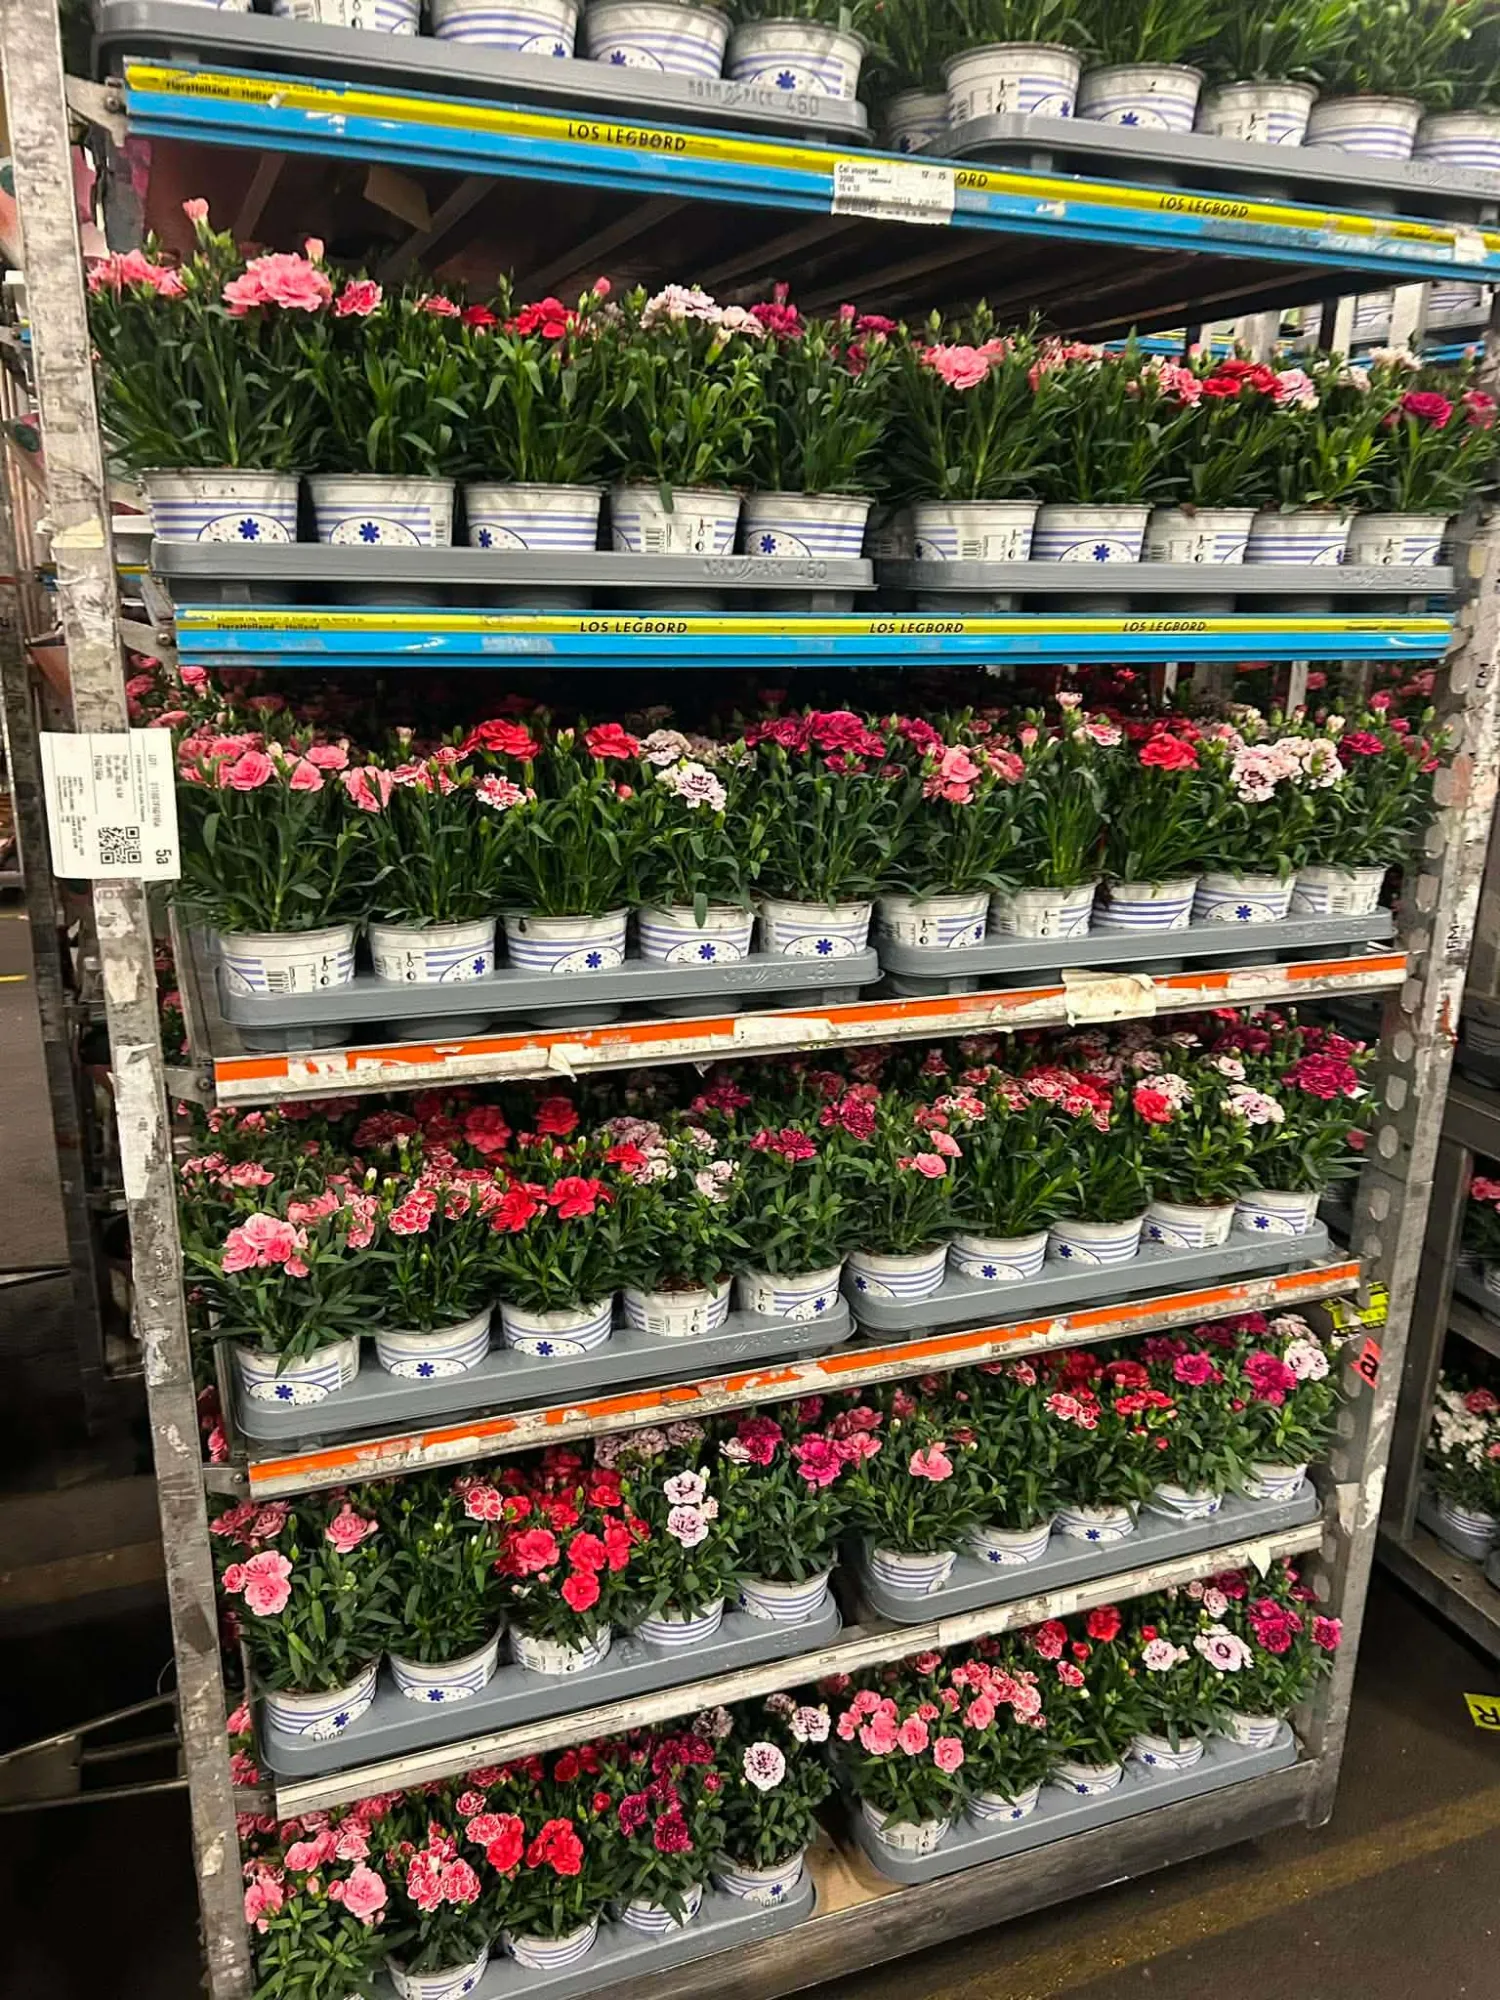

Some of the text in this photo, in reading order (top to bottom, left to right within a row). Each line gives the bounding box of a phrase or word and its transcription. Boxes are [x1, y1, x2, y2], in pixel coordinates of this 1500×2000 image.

[568, 123, 687, 152] LOS LEGBORD
[956, 172, 988, 188] ORD
[1159, 195, 1250, 219] LOS LEGBORD
[579, 620, 688, 633] LOS LEGBORD
[869, 622, 964, 634] LOS LEGBORD
[1122, 621, 1207, 634] LOS LEGBORD
[155, 849, 172, 865] 5a
